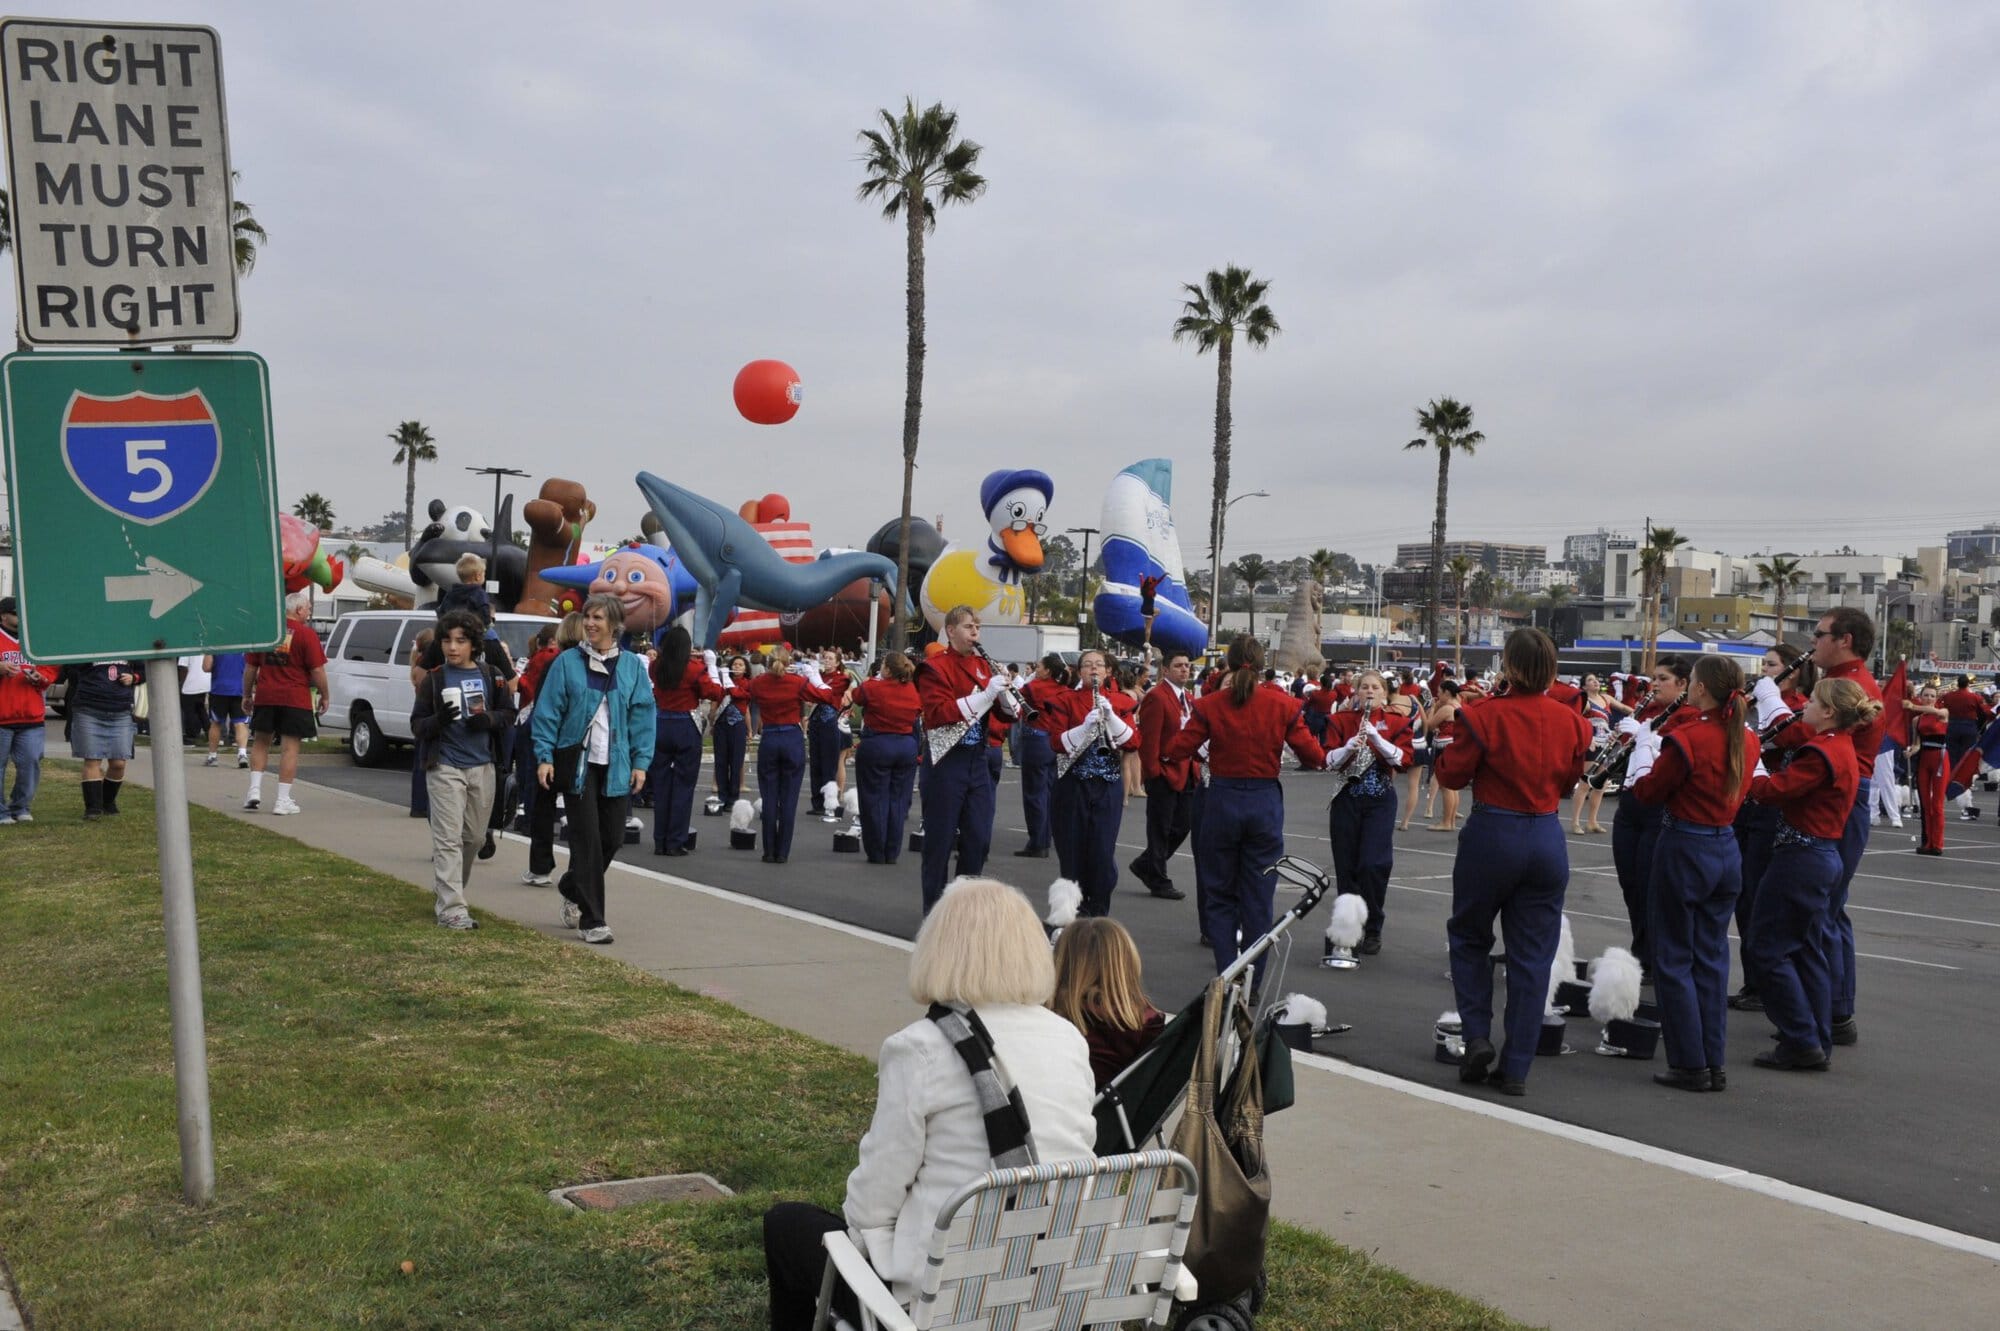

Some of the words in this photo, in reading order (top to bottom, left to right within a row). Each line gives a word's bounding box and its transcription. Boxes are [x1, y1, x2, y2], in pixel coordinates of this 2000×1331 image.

[17, 38, 201, 87] RIGHT
[30, 100, 202, 148] LANE
[35, 162, 204, 208] MUST
[39, 223, 209, 267] TURN
[36, 283, 214, 329] RIGHT
[125, 439, 174, 503] 5
[1934, 661, 1966, 669] PERFECT
